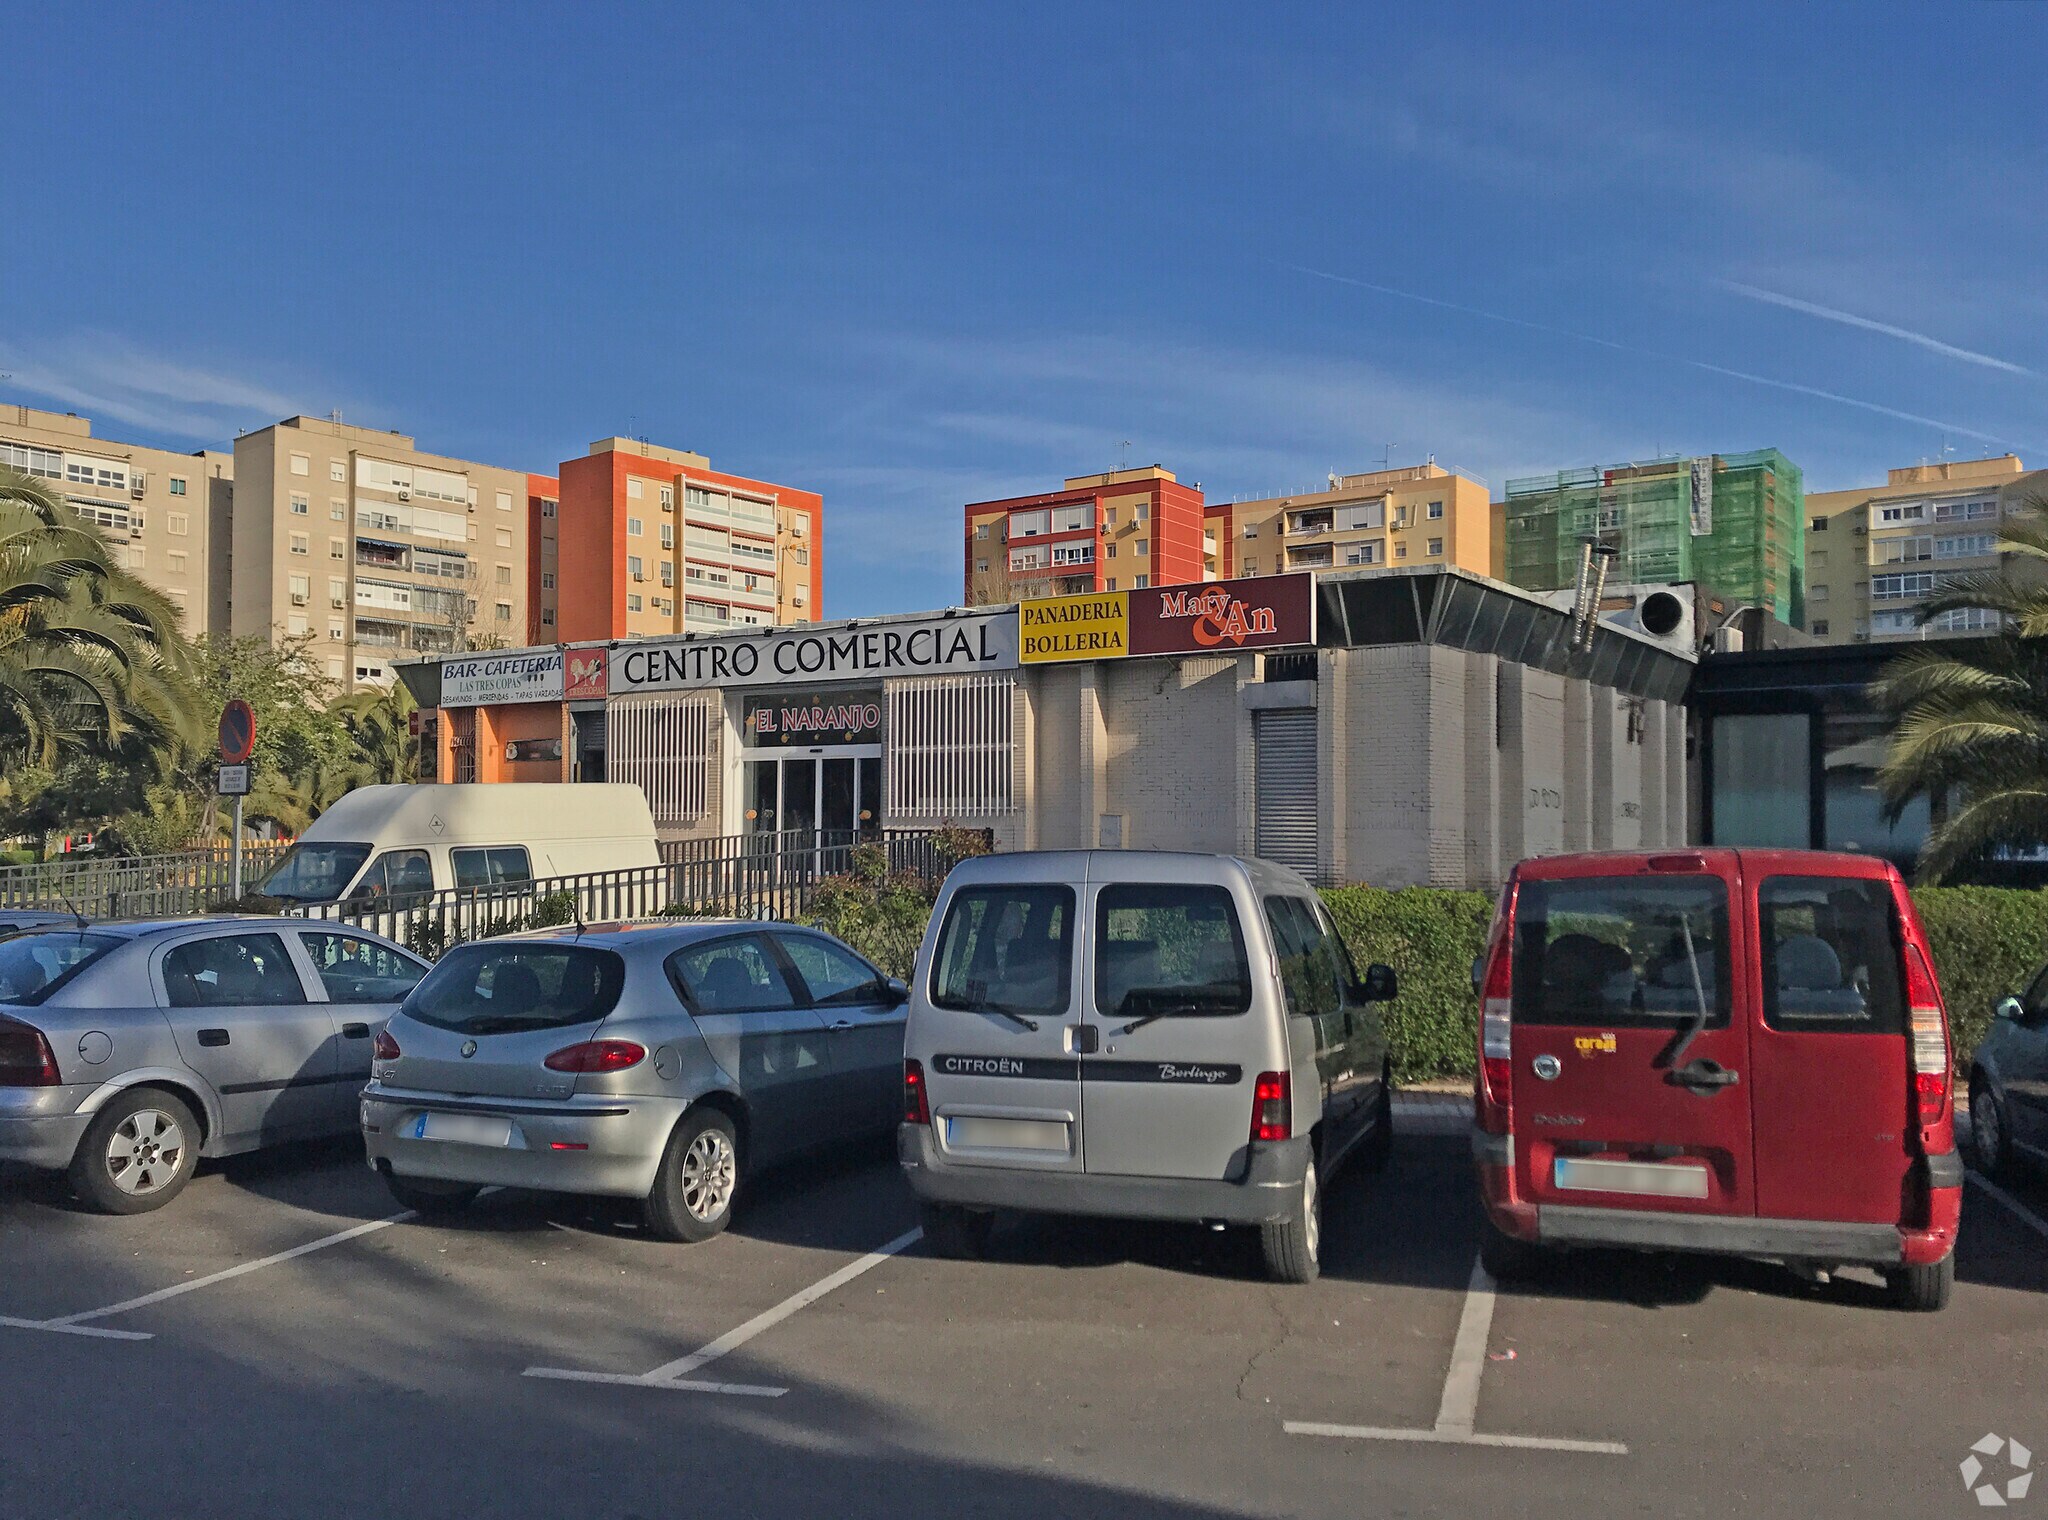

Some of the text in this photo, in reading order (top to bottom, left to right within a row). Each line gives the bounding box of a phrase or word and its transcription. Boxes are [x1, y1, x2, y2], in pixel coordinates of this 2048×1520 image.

[1024, 600, 1123, 625] PANADERIA
[1159, 590, 1231, 620] Mary
[1220, 600, 1277, 637] An
[624, 625, 998, 684] CENTRO COMERCIAL
[1024, 630, 1123, 654] BOLLERIA
[459, 677, 521, 693] LAS TRES COPAS
[515, 691, 533, 699] TAPAS
[756, 703, 881, 733] EL NARANJO
[945, 1057, 1228, 1082] CITROËN Berlingo
